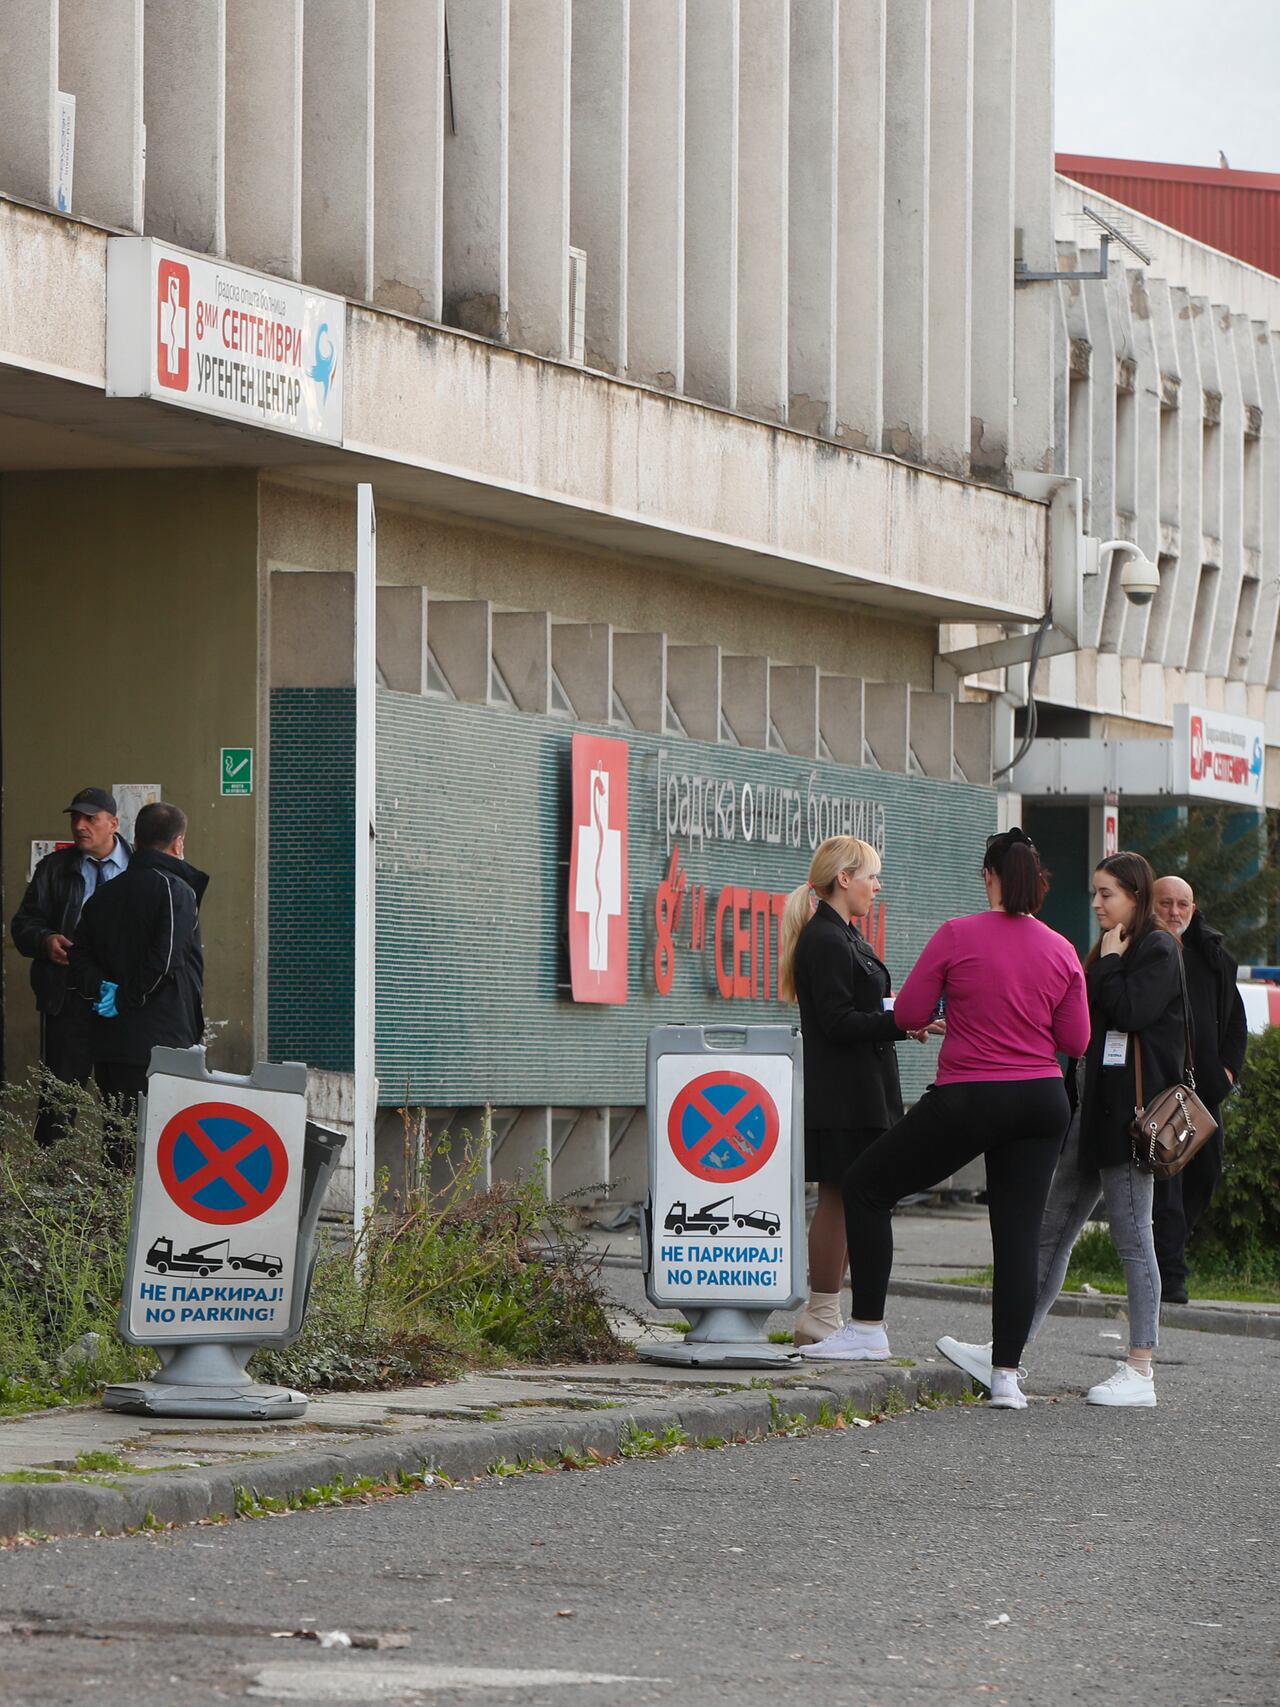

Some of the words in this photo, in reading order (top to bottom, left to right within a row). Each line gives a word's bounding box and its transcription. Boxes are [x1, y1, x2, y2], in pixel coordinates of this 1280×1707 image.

[215, 274, 240, 304] Градска
[222, 308, 302, 367] СЕПТЕМВРИ
[197, 352, 254, 405] УРГЕНТЕН
[258, 367, 301, 418] ЦЕНТАР
[656, 749, 737, 857] Градска
[741, 782, 802, 848] општа
[661, 1246, 684, 1262] НЕ
[687, 1246, 783, 1263] ПАРКИРАЈ!
[668, 1270, 693, 1285] NO
[697, 1270, 777, 1286] PARKING!
[140, 1283, 167, 1301] НЕ
[172, 1285, 283, 1302] ПАРКИРАЈ!
[146, 1308, 175, 1323] NO
[180, 1307, 274, 1322] PARKING!
